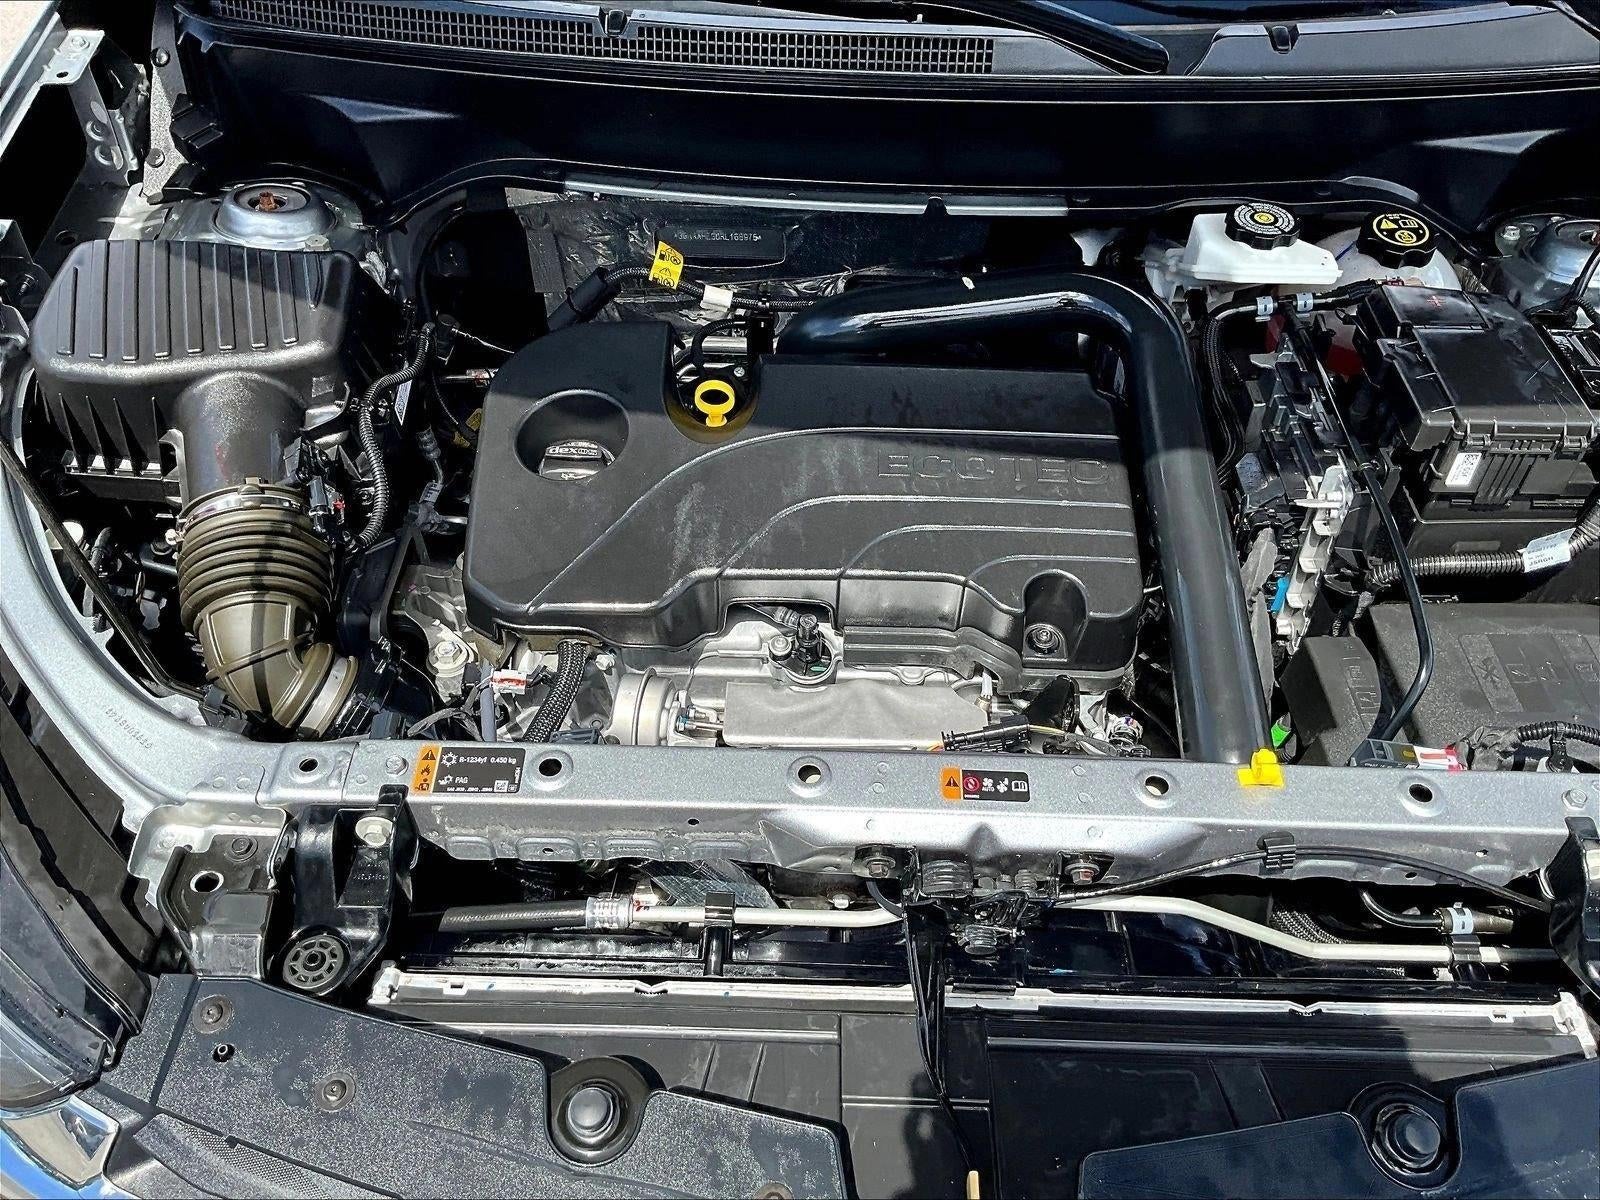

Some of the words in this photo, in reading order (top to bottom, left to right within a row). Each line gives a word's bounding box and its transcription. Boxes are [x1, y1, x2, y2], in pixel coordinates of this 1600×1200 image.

[549, 446, 598, 456] dexos
[878, 455, 1110, 484] ECOTEC
[459, 756, 487, 764] R-1234yf
[490, 756, 507, 764] 0.450
[508, 756, 517, 764] kg
[455, 776, 468, 784] PAG
